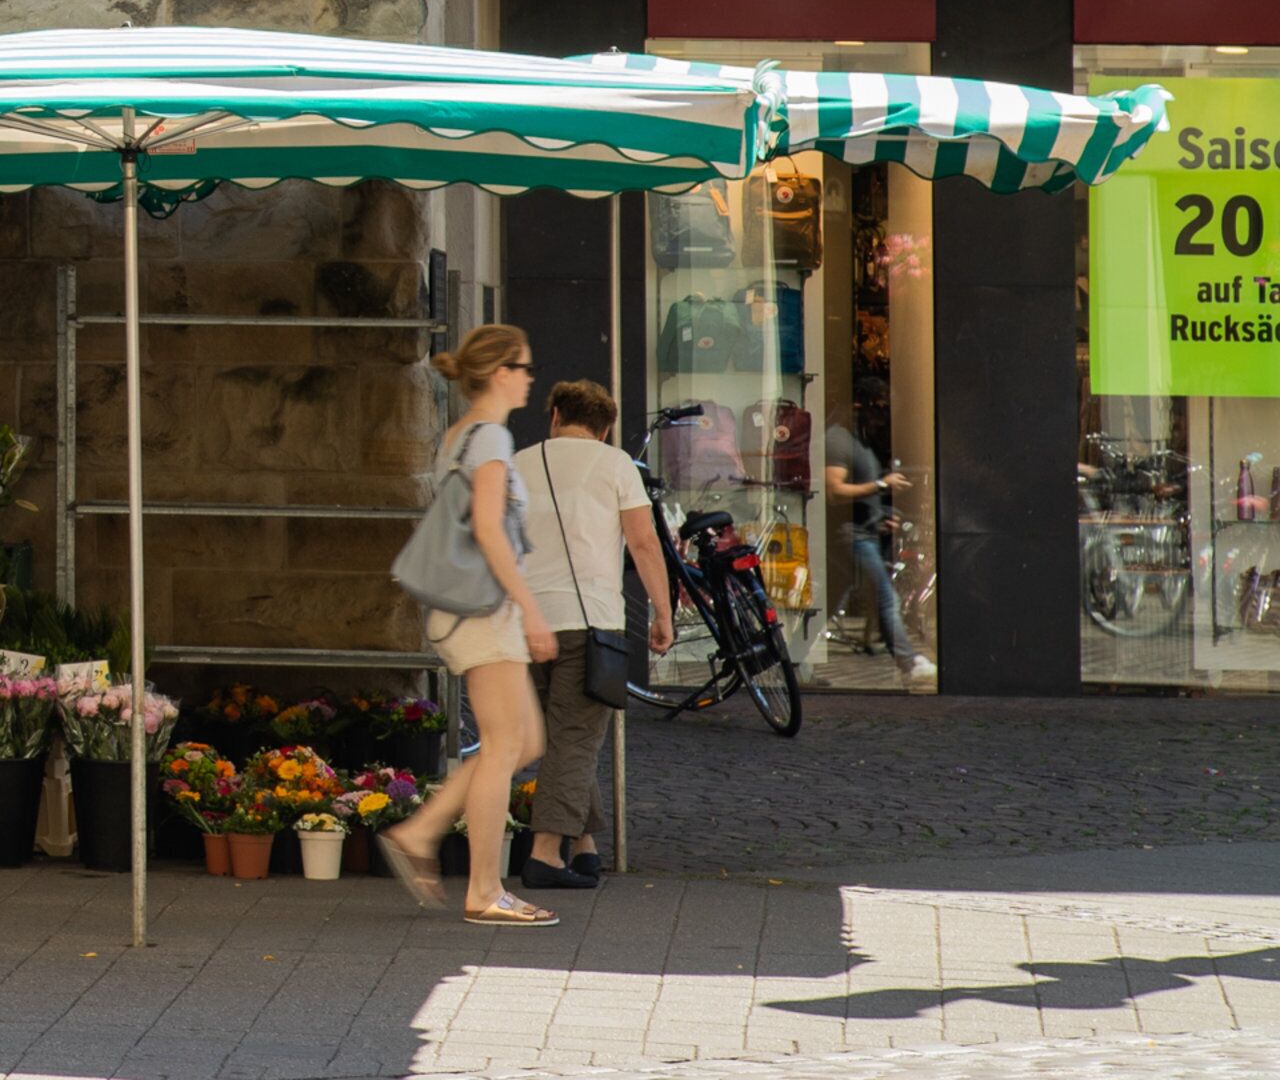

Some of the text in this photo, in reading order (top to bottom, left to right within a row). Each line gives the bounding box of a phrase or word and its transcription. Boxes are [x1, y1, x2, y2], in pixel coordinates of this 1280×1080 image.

[1177, 126, 1280, 170] Sais
[1174, 193, 1264, 257] 20
[1197, 275, 1242, 303] auf
